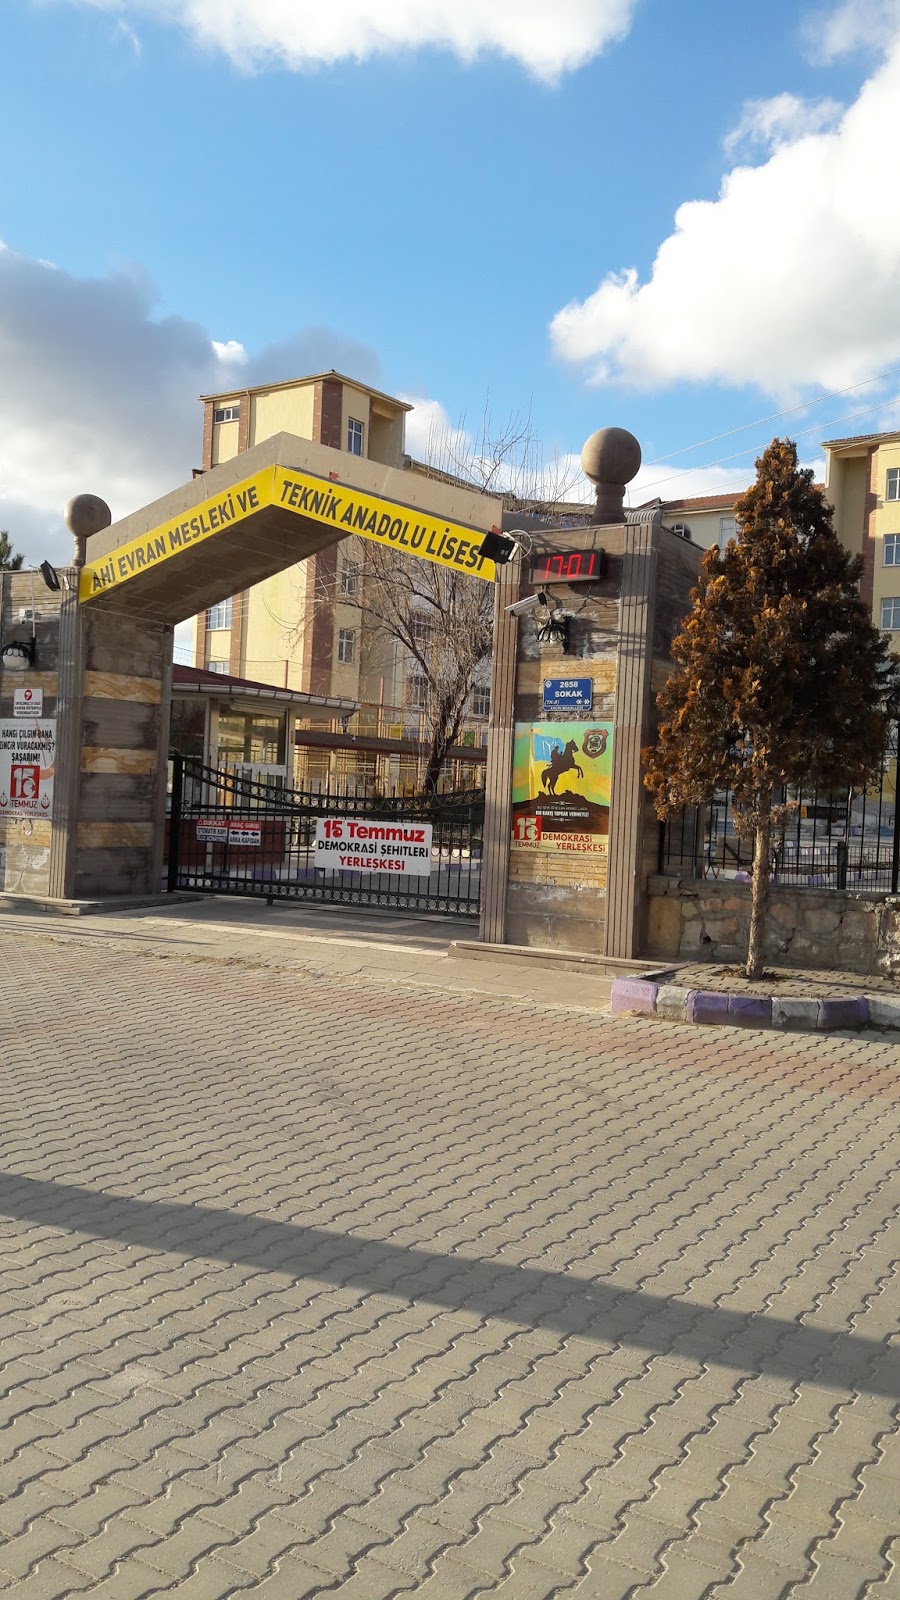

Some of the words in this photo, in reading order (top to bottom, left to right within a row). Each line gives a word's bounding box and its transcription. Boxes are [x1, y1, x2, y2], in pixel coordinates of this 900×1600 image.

[280, 480, 342, 520] TEKNİK
[340, 502, 426, 549] ANADOLU
[92, 557, 116, 592] AHİ
[118, 535, 167, 578] EVRAN
[168, 493, 236, 551] MESLEKİ
[236, 485, 260, 514] VE
[18, 730, 36, 740] ÇILGIN
[38, 730, 53, 739] BANA
[14, 768, 36, 798] 15
[11, 800, 38, 809] TEMMUZ
[324, 820, 343, 838] 15
[347, 822, 425, 842] Temmuz
[517, 817, 538, 840] 15
[542, 833, 592, 842] DEMOKRASİ
[318, 840, 378, 854] DEMOKRASİ
[380, 844, 428, 857] ŞEHİTLERİ
[556, 843, 606, 853] YERLEŞKESİ
[339, 856, 404, 871] YERLEŞKESİ
